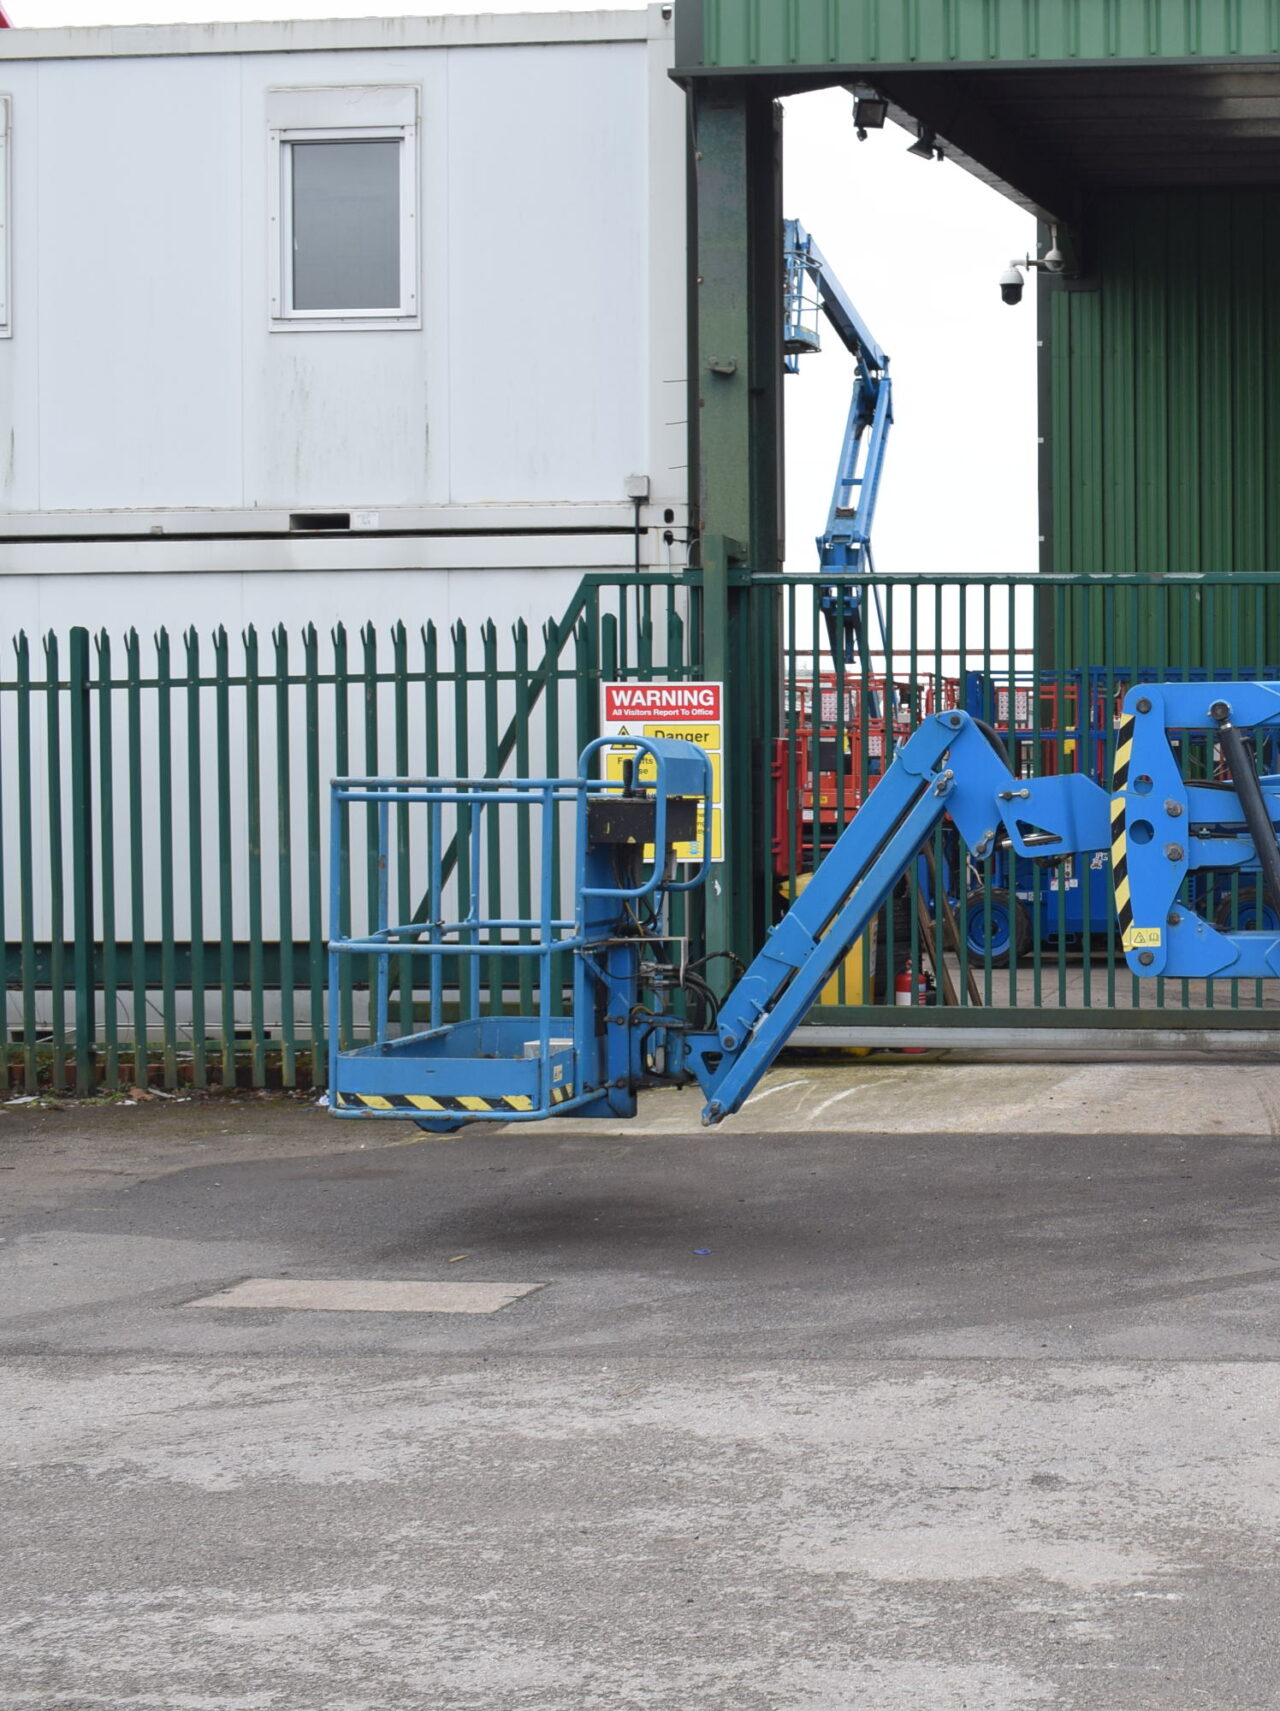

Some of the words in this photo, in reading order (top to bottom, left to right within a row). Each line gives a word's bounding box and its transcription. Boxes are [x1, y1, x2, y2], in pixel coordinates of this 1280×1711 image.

[611, 689, 714, 706] WARNING
[653, 709, 679, 717] Report
[691, 708, 714, 716] Office
[654, 730, 710, 743] Danger
